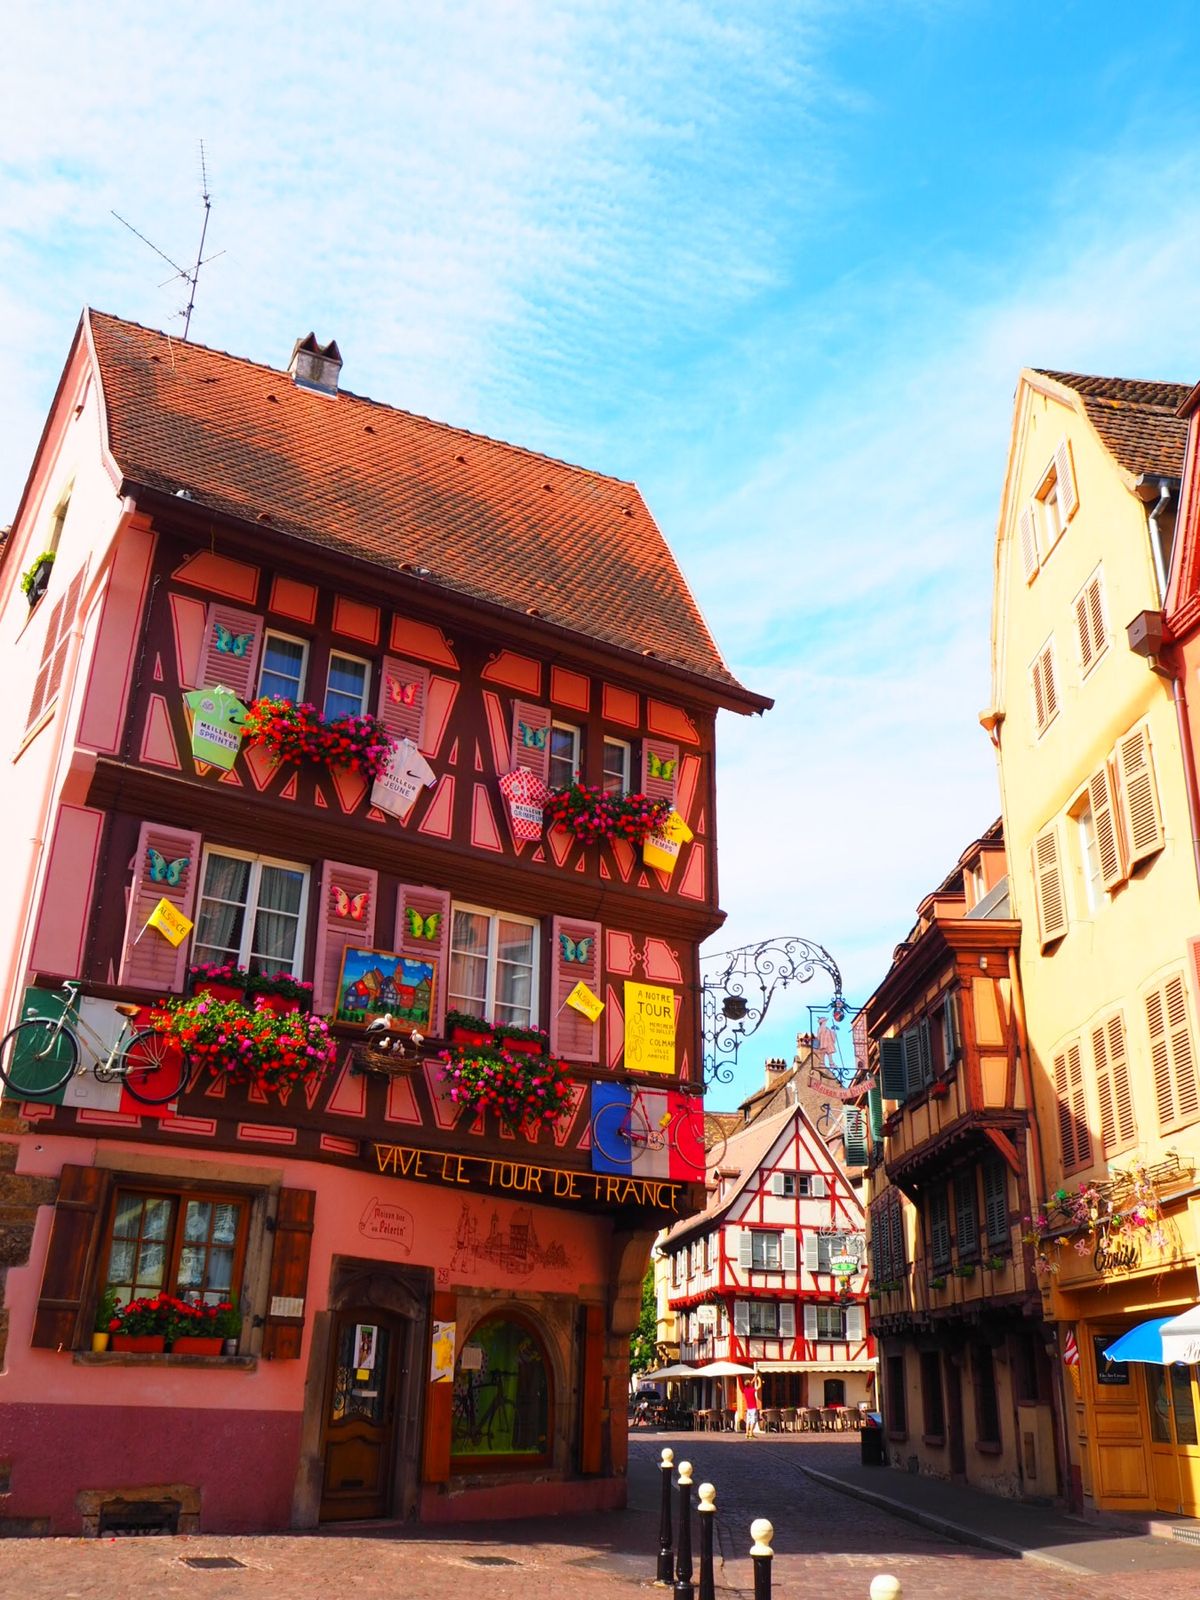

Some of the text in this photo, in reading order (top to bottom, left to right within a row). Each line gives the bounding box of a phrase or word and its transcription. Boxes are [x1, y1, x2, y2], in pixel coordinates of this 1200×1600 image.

[199, 729, 239, 750] SPRINTER
[201, 722, 238, 740] MEILLEUR
[384, 781, 411, 798] JEUNE
[515, 804, 541, 816] MEILLEUR
[651, 838, 673, 852] TEMPS
[645, 991, 671, 1004] NOTRE
[637, 1001, 672, 1019] TOUR
[374, 1144, 682, 1214] VIVE LE TOUR DE FRANCE
